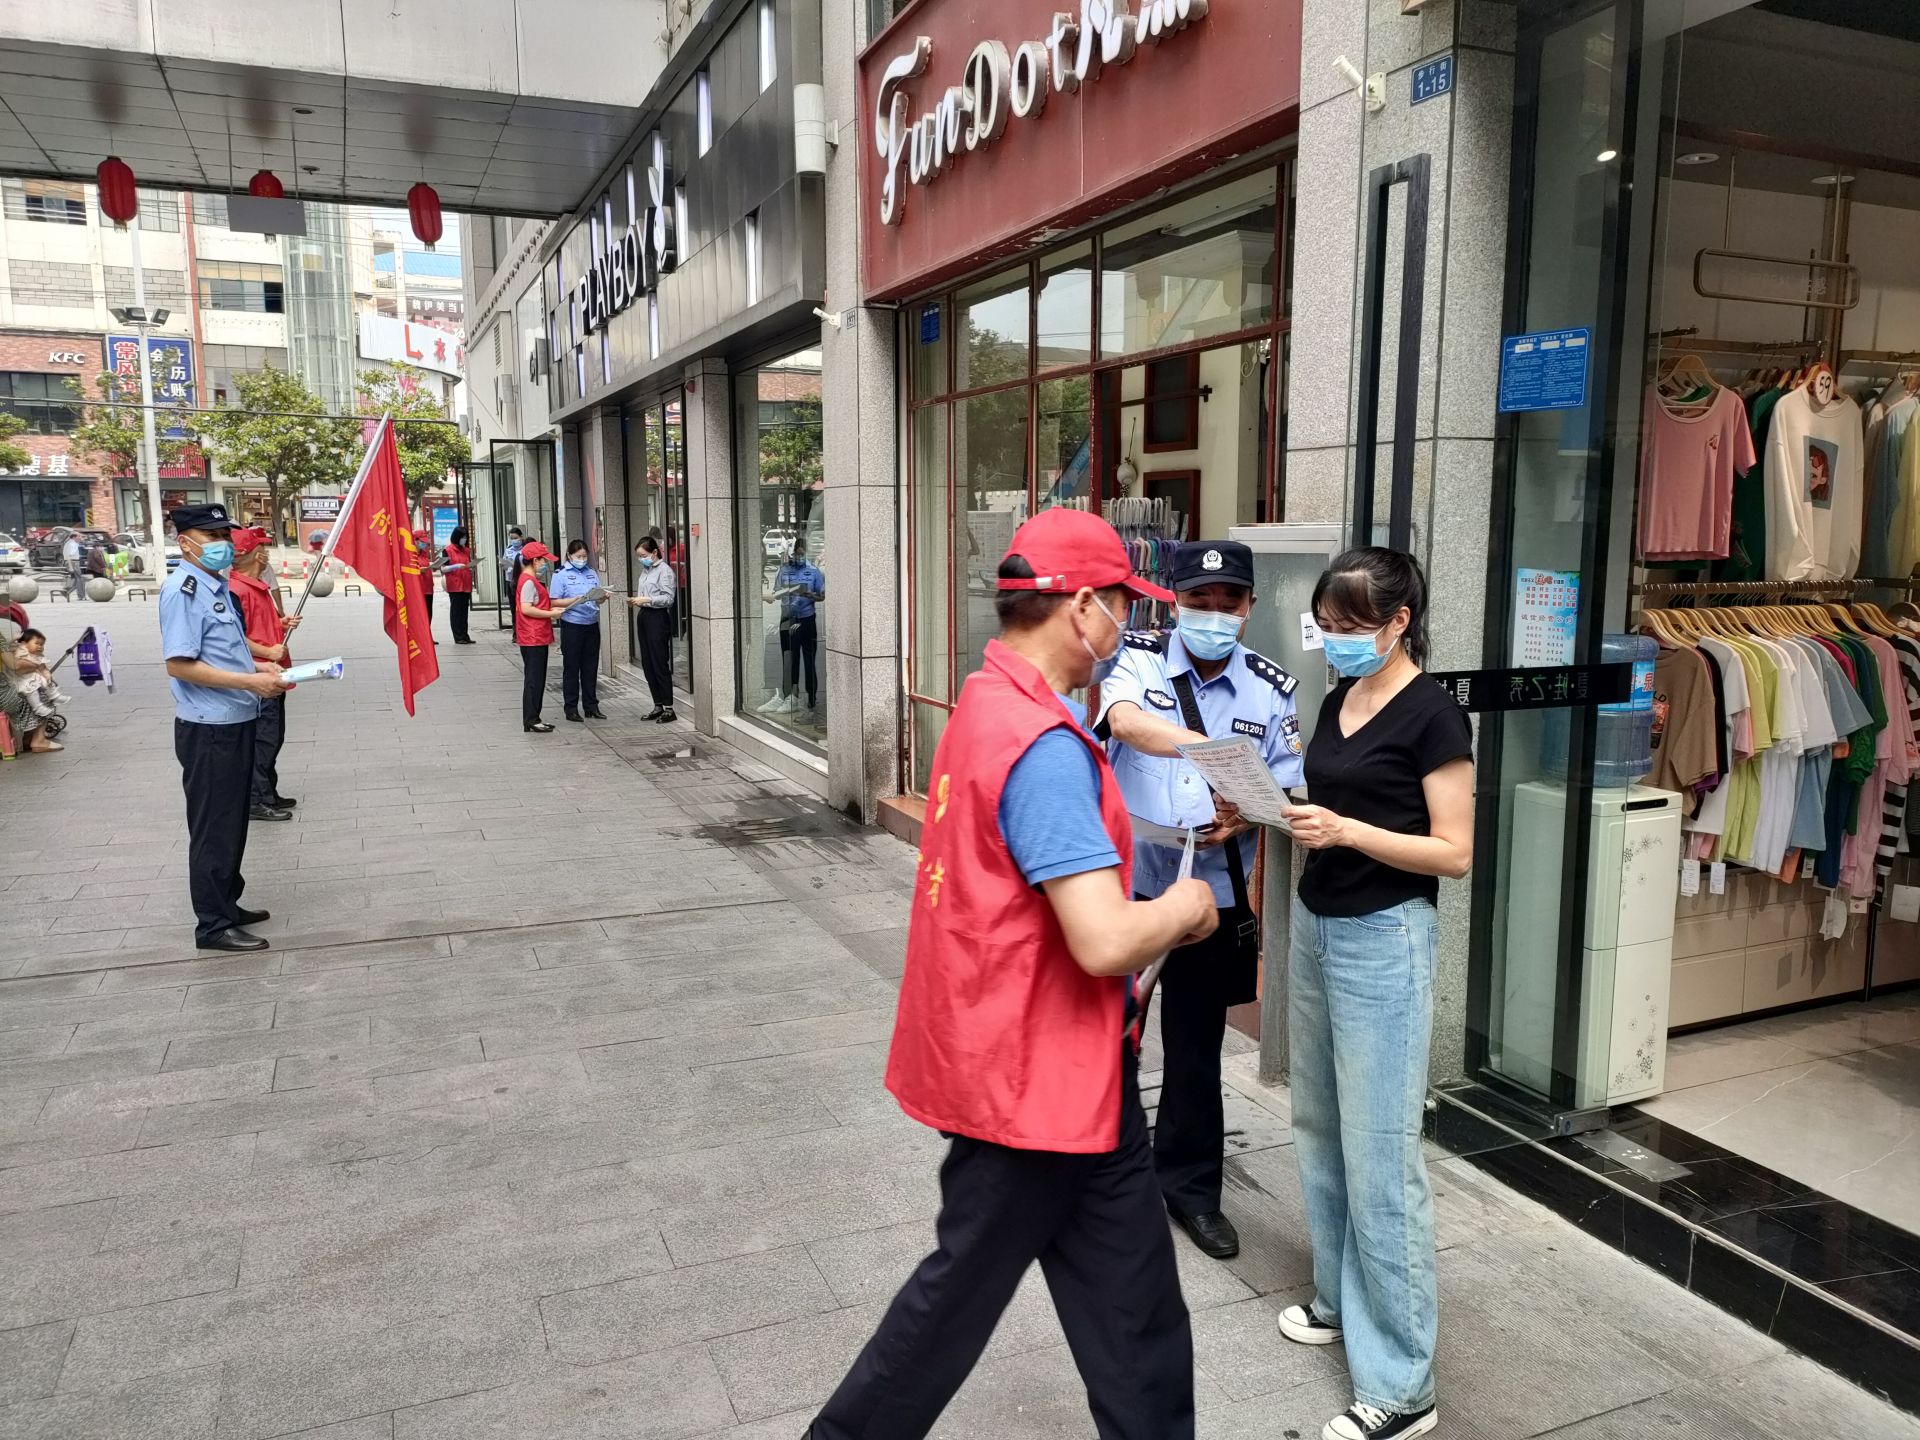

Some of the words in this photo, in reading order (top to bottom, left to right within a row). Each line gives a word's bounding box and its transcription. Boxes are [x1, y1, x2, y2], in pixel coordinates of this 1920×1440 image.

[1418, 73, 1446, 98] 1-15
[579, 207, 652, 335] PLAYBOY
[48, 352, 86, 364] KFC
[1819, 375, 1832, 400] 59
[1233, 720, 1265, 737] 061201
